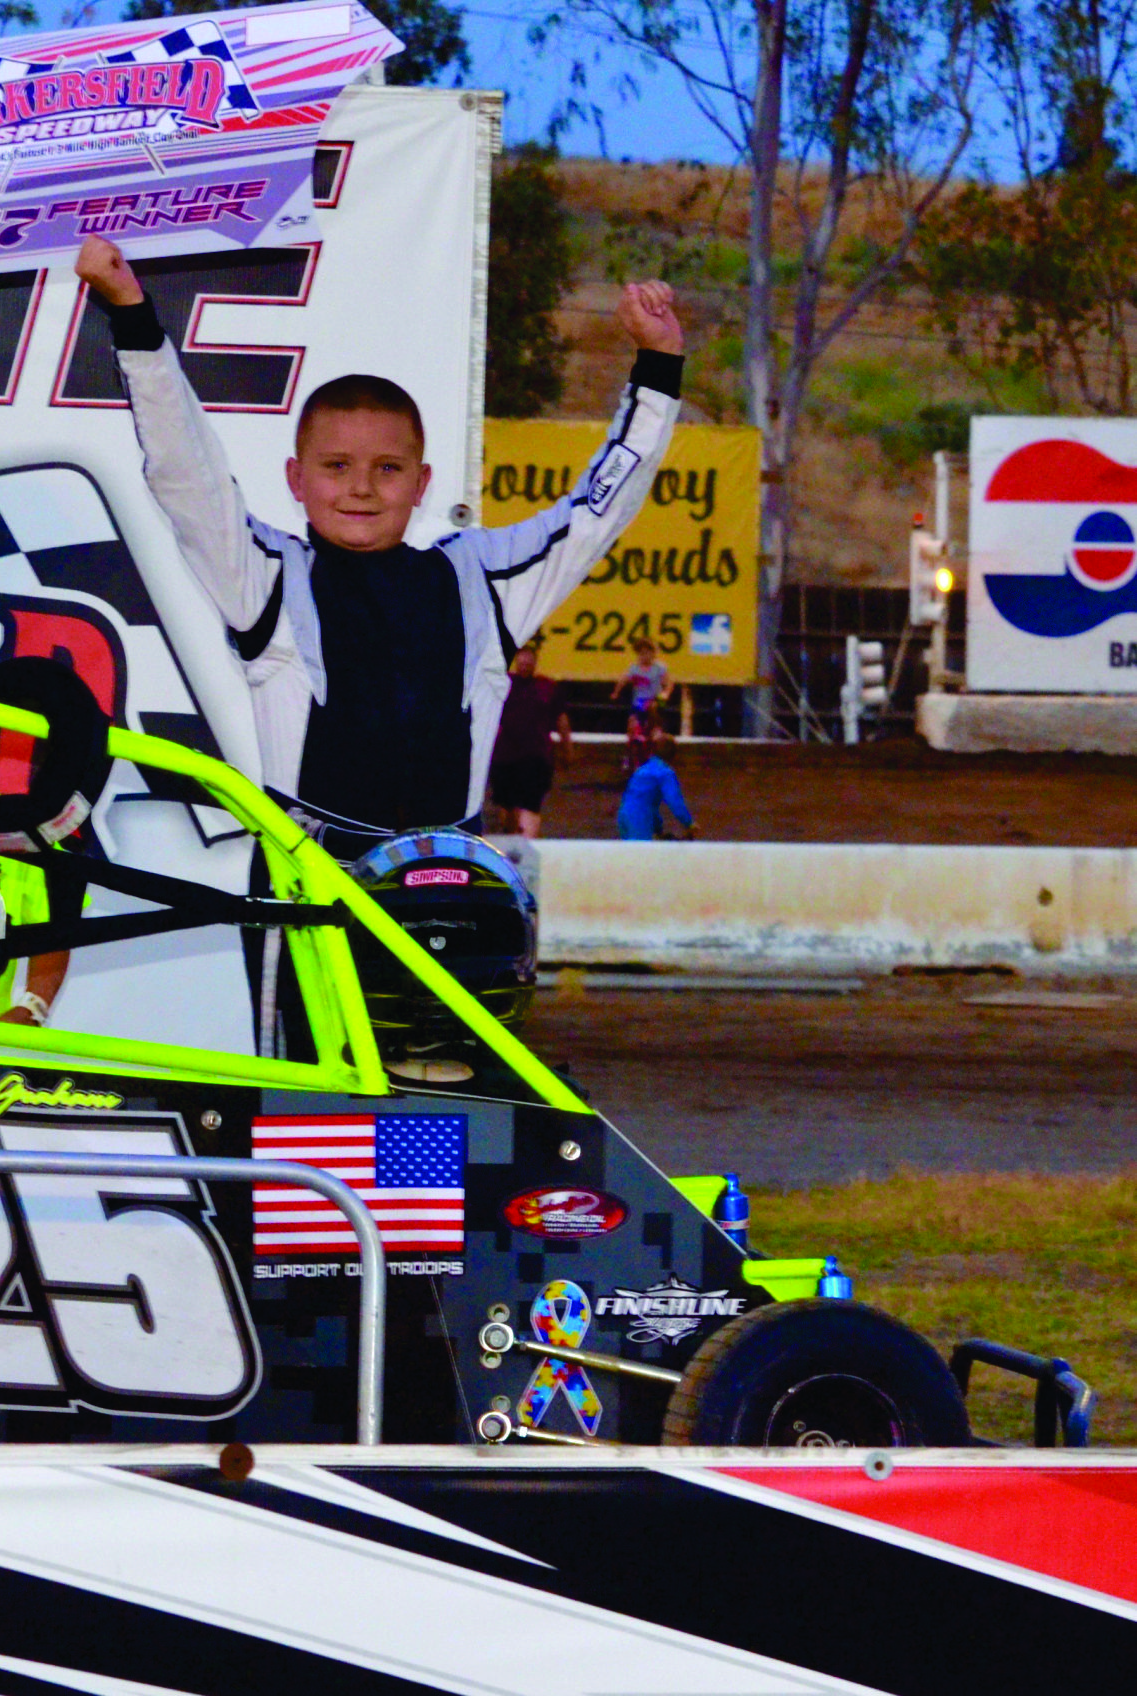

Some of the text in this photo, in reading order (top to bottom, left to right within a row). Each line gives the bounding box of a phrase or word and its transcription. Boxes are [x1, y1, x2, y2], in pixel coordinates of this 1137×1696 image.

[47, 178, 271, 221] FEATURE
[76, 199, 264, 236] WINNER
[409, 868, 466, 885] SIMPSON
[253, 1263, 341, 1279] SUPPORT
[387, 1261, 465, 1276] TROOPS
[594, 1297, 748, 1316] FINISHLINE
